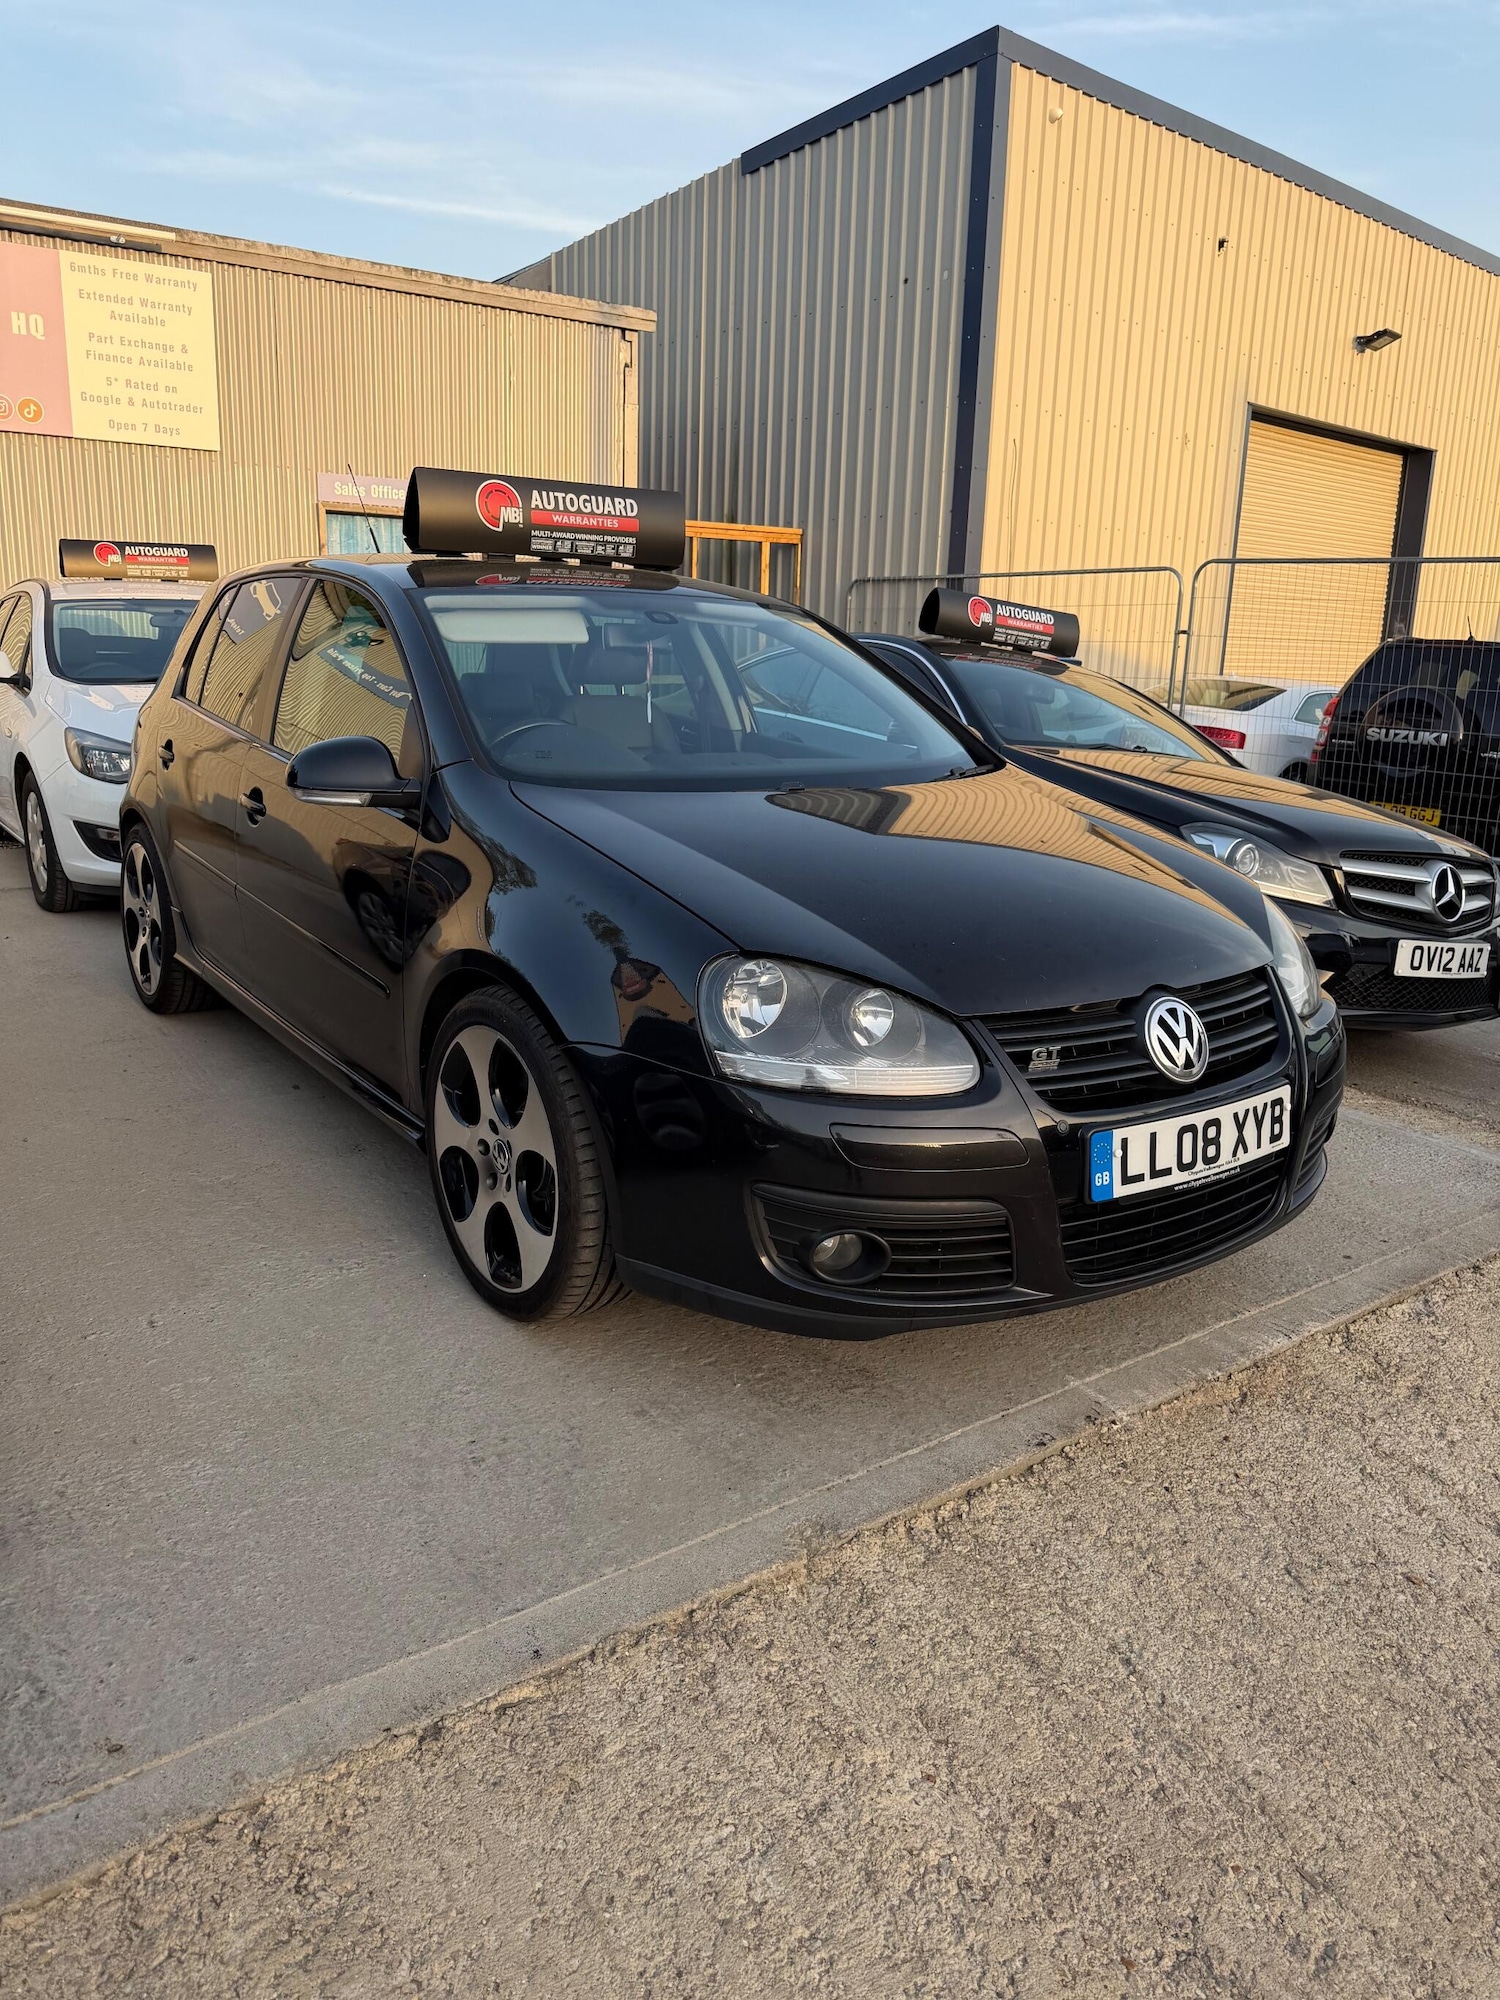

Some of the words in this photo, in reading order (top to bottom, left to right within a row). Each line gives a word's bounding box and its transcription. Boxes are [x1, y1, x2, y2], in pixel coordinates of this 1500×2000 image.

[69, 261, 107, 277] 6mths
[112, 268, 139, 282] Free
[144, 272, 198, 292] Warranty
[78, 288, 134, 306] Extended
[139, 297, 193, 316] Warranty
[10, 311, 46, 340] HQ
[109, 310, 166, 328] Available
[88, 332, 114, 345] Part
[120, 336, 175, 353] Exchange
[181, 344, 189, 354] &
[86, 349, 133, 365] Finance
[138, 356, 194, 372] Available
[125, 378, 159, 392] Rated
[165, 385, 178, 394] on
[80, 391, 121, 407] Google
[127, 396, 136, 407] &
[141, 398, 204, 414] Autotrader
[108, 419, 137, 432] Open
[142, 422, 148, 432] 7
[154, 424, 181, 436] Days
[334, 481, 366, 497] Sales
[370, 484, 406, 500] Office
[531, 489, 638, 517] AUTOGUARD
[500, 506, 523, 524] MBi
[552, 513, 619, 528] WARRANTIES
[531, 529, 575, 540] MULTI-AWARD
[575, 533, 603, 542] WINNING
[603, 535, 637, 544] PROVIDERS
[125, 545, 188, 558] AUTOGUARD
[137, 556, 177, 564] WARRANTIES
[996, 604, 1054, 625] AUTOGUARD
[1007, 618, 1044, 631] WARRANTIES
[1366, 727, 1449, 747] SUZUKI
[1410, 945, 1456, 973] OV12
[1457, 947, 1484, 973] AAZ
[1031, 1046, 1061, 1061] GT
[1120, 1117, 1222, 1186] LL08
[1232, 1096, 1285, 1158] XYB
[1094, 1171, 1110, 1187] GB
